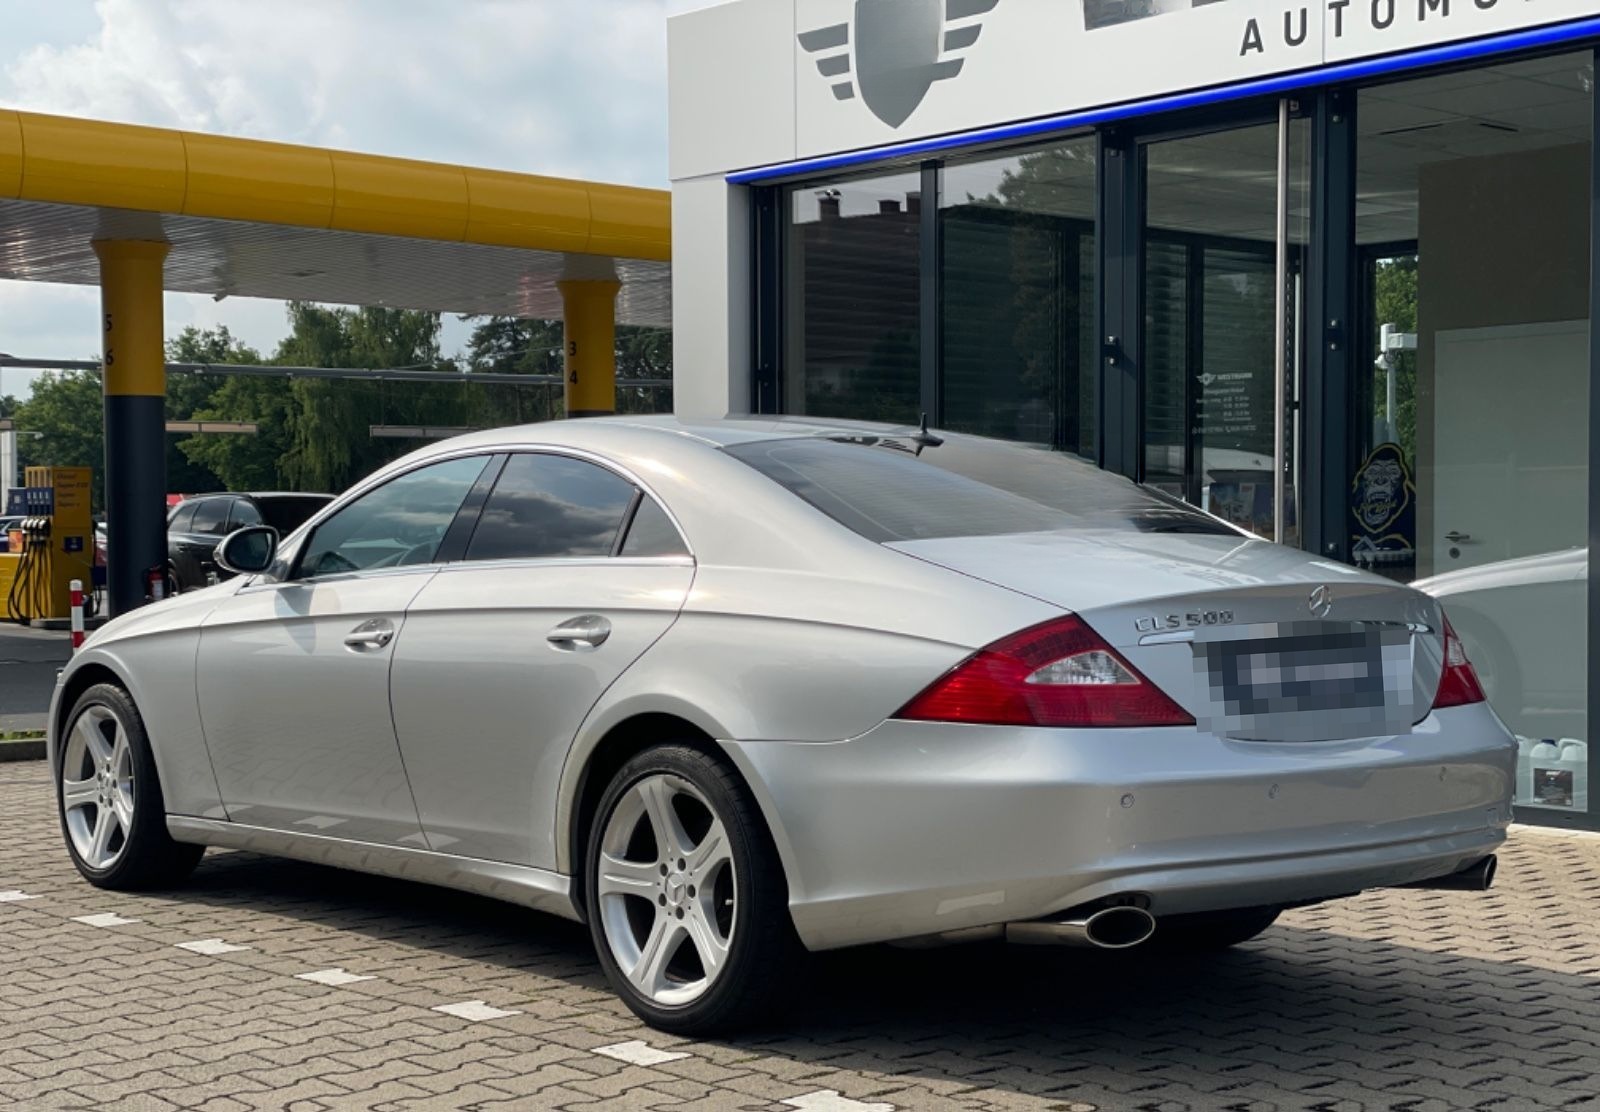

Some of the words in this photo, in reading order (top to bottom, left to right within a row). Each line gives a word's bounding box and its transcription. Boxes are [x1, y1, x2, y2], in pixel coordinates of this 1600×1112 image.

[105, 313, 112, 331] 5
[569, 341, 577, 356] 3
[105, 349, 114, 366] 6
[569, 370, 578, 385] 4
[1135, 615, 1180, 632] CLS
[1185, 611, 1234, 626] 500
